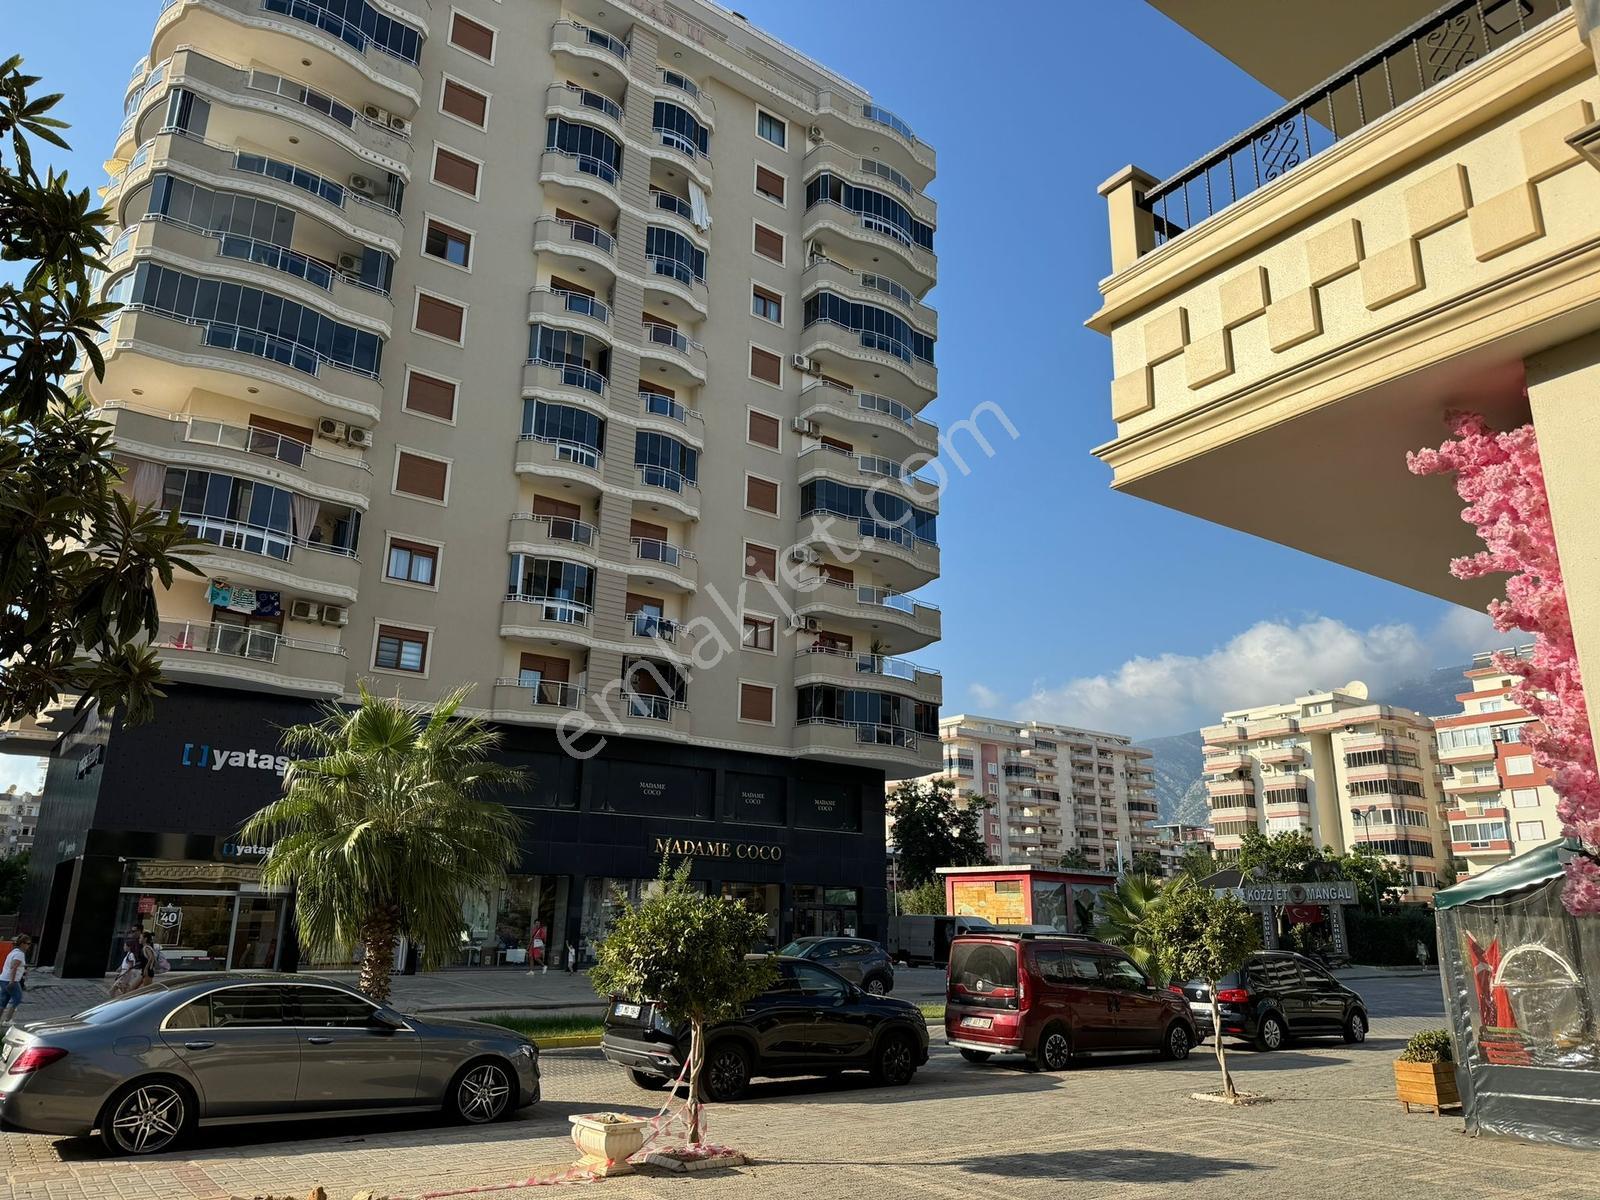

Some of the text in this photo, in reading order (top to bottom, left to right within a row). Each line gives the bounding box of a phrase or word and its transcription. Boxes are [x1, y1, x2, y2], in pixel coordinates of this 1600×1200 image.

[639, 782, 666, 791] MADAME
[643, 788, 662, 796] COCO
[742, 791, 765, 799] MADAME
[654, 837, 782, 861] MADAME COCO
[1305, 887, 1351, 900] MANGAL
